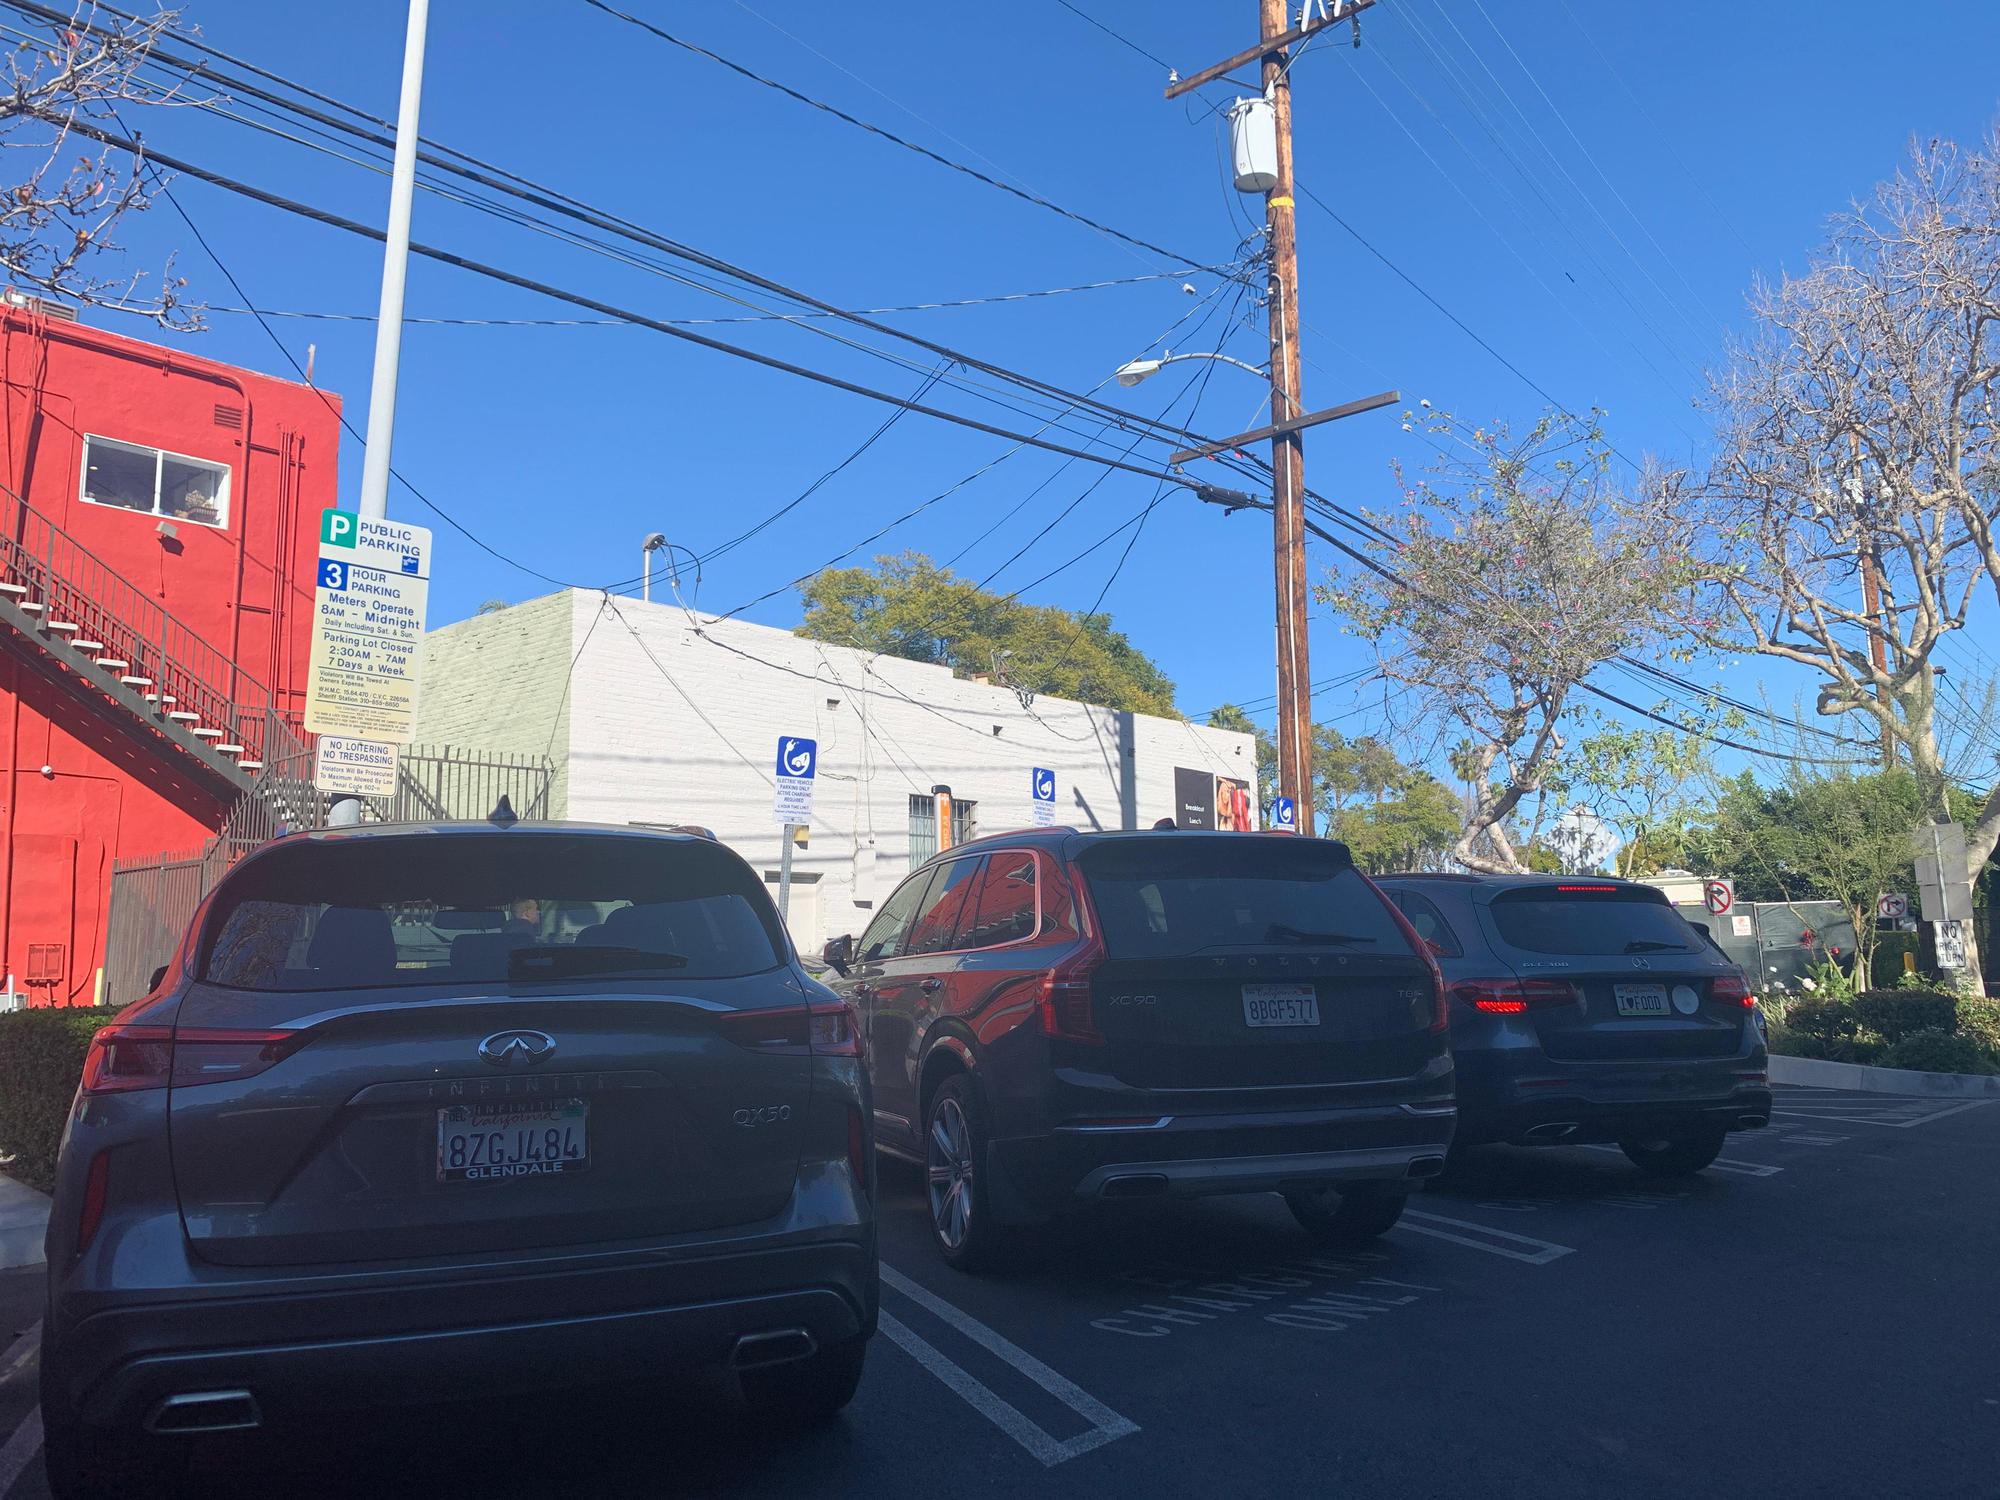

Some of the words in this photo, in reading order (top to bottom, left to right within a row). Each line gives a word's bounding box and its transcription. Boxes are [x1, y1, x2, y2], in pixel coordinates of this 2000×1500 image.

[329, 514, 351, 542] P
[360, 522, 412, 541] PUBLIC
[359, 536, 421, 557] PARKING
[325, 563, 343, 588] 3
[352, 569, 386, 583] HOUR
[351, 582, 401, 599] PARKING
[329, 592, 367, 608] Meters
[372, 600, 415, 616] Operate
[321, 604, 345, 617] 8AM
[365, 611, 420, 630] Midnight
[325, 617, 342, 628] Daily
[344, 620, 375, 633] Including
[377, 626, 390, 635] Sat.
[400, 630, 415, 638] Sun.
[323, 631, 360, 647] Parking
[362, 638, 378, 649] Lot
[380, 640, 414, 654] Closed
[329, 645, 371, 660] 2:30AM
[385, 653, 407, 665] 7AM
[328, 656, 335, 665] 7
[337, 658, 363, 670] Days
[367, 664, 374, 672] a
[378, 664, 405, 676] Week
[319, 670, 344, 679] Violators
[366, 676, 383, 684] Towed
[319, 677, 340, 685] Owners
[329, 740, 342, 750] NO
[345, 742, 389, 755] LOITERING
[323, 750, 336, 759] NO
[338, 751, 393, 765] TRESPASSING
[321, 765, 344, 773] Violators
[1941, 925, 1957, 939] NO
[1939, 941, 1962, 951] RIGHT
[1939, 953, 1964, 963] TURN
[1249, 999, 1313, 1020] 8BGF577
[732, 1104, 791, 1128] QX50
[449, 1126, 580, 1168] 8ZGJ484
[465, 1161, 564, 1179] GLENDALE
